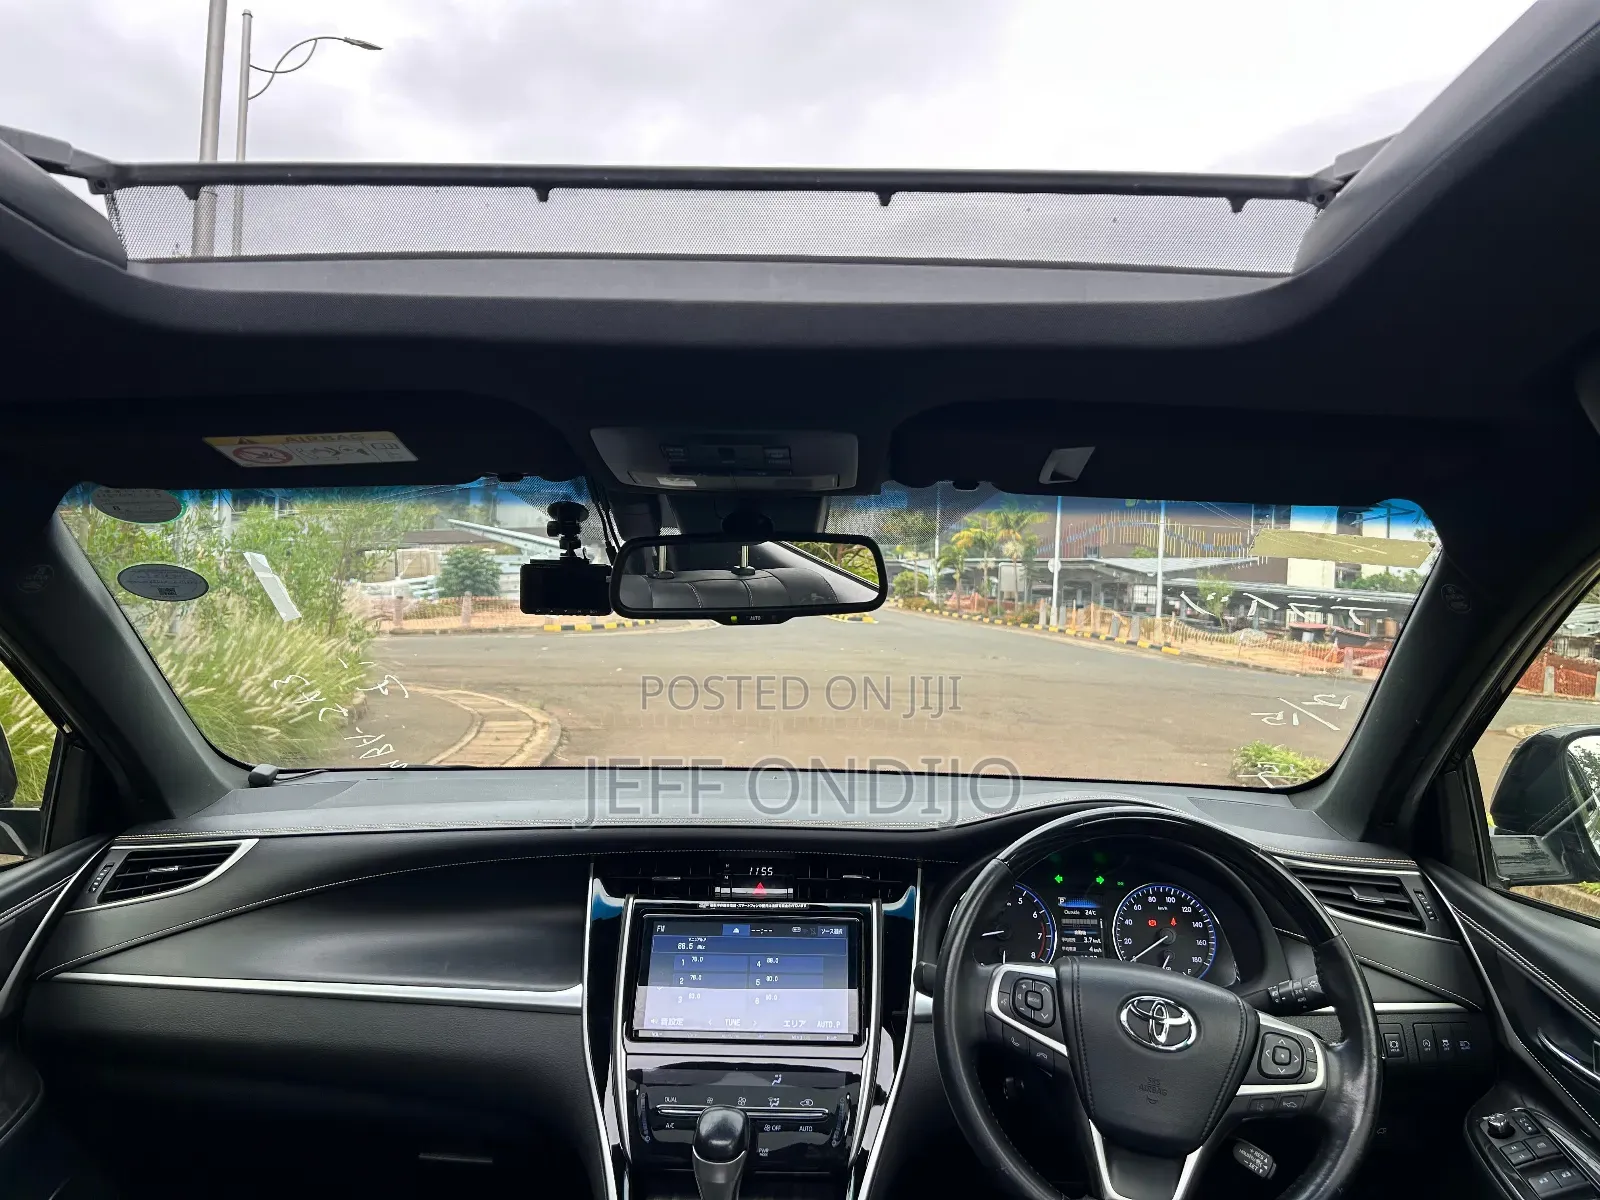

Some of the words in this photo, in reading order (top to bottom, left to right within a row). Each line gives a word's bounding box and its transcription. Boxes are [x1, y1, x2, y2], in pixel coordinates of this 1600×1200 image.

[285, 433, 365, 444] AIRBAG
[1018, 897, 1023, 905] 5
[1032, 911, 1038, 919] 6
[1030, 951, 1036, 959] 8
[724, 1018, 741, 1027] TUNE
[783, 1019, 807, 1028] エリア
[816, 1020, 841, 1029] AUTO.P
[1138, 1083, 1168, 1097] AIRBAG
